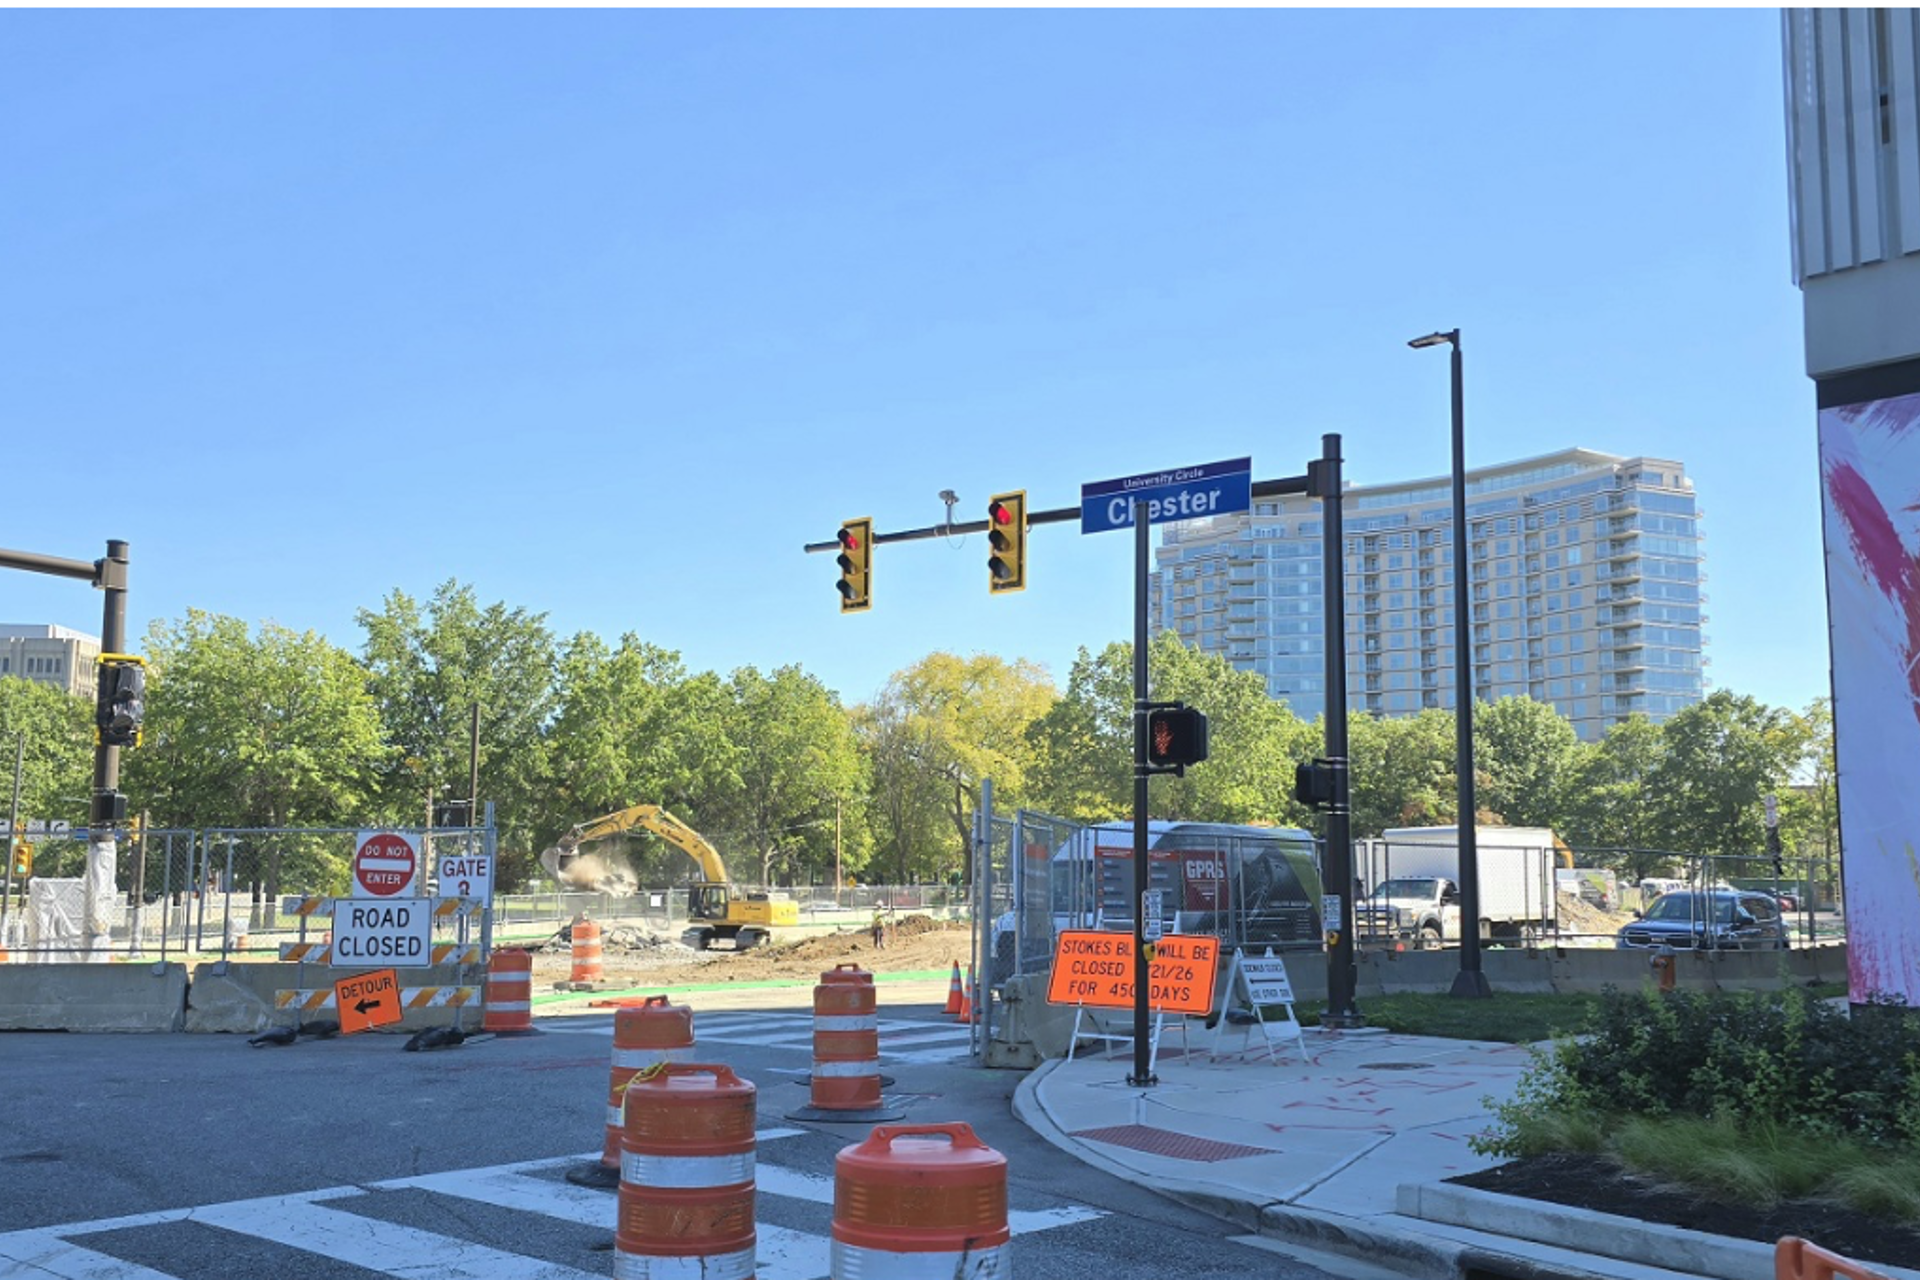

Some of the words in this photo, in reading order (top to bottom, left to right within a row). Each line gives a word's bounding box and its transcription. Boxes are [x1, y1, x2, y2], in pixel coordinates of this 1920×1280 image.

[1123, 472, 1174, 490] University
[1175, 467, 1204, 481] Circle
[365, 845, 380, 856] DO
[386, 845, 408, 857] NOT
[366, 873, 401, 884] ENTER
[443, 859, 487, 878] GATE
[1186, 860, 1224, 878] GPRS
[352, 907, 410, 928] ROAD
[339, 936, 422, 957] CLOSED
[1062, 940, 1112, 956] STOKES
[1156, 943, 1186, 960] WILL
[1192, 945, 1210, 960] BE
[1071, 960, 1125, 976] CLOSED
[341, 976, 393, 999] DETOUR
[1068, 981, 1098, 995] FOR
[1150, 986, 1191, 1001] DAYS
